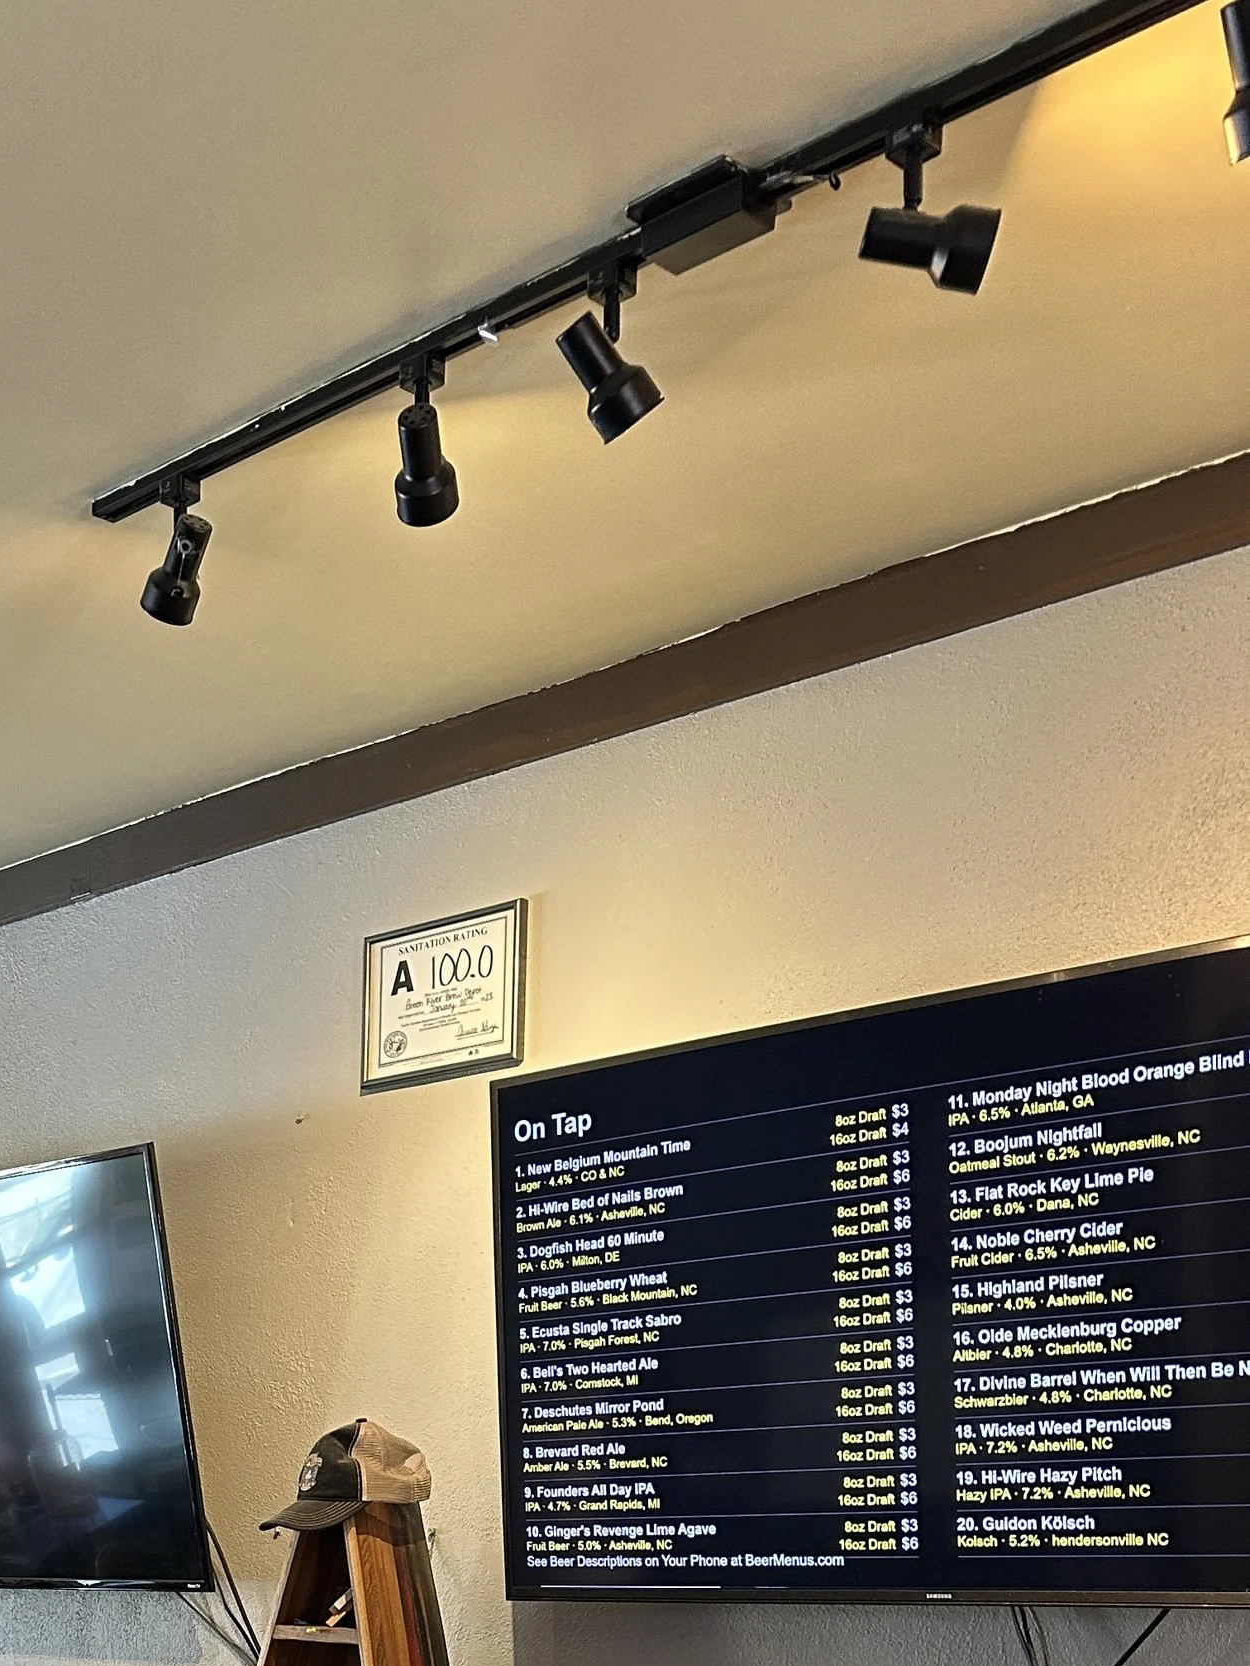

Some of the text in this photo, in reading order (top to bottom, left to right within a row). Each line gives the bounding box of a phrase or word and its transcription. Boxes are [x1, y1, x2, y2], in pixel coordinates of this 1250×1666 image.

[398, 926, 489, 956] SANITATION RATING
[391, 944, 494, 996] A 100.0
[947, 1050, 1244, 1110] 11. Monday Night Blood Orange Blind
[514, 1111, 593, 1143] On Tap
[834, 1102, 909, 1127] 8oz Draft $3
[948, 1121, 1102, 1157] 12. Boojum Nightfall
[515, 1140, 691, 1178] 1. New Belgium Mountain Time
[949, 1166, 1154, 1204] 13. Flat Rock Key Lime Pie
[515, 1184, 684, 1219] 2. Hi-Wire Bed of Nails Brown
[516, 1229, 664, 1259] 3. Dogfish Head 60 Minute
[950, 1220, 1123, 1252] 14. Noble Cherry Cider
[517, 1270, 668, 1299] 4. Pisgah Blueberry Wheat
[952, 1316, 1182, 1346] 16. Olde Mecklenburg Copper
[520, 1356, 658, 1380] 6. Bell's Two Hearted Ale
[521, 1398, 664, 1419] 7. Deschutes Mirror Pond
[954, 1415, 1172, 1439] 18. Wicked Weed Pernicious
[523, 1482, 655, 1498] 9. Founders All Day IPA
[525, 1522, 716, 1540] 10. Ginger's Revenge Lime Agave
[956, 1514, 1095, 1531] 20. Guidon Kölsch
[957, 1534, 998, 1547] Kolsch
[1051, 1533, 1144, 1547] hendersonville
[1146, 1532, 1169, 1546] NC
[526, 1553, 844, 1570] See Beer Descriptions on Your Phone at BeerMenus.com
